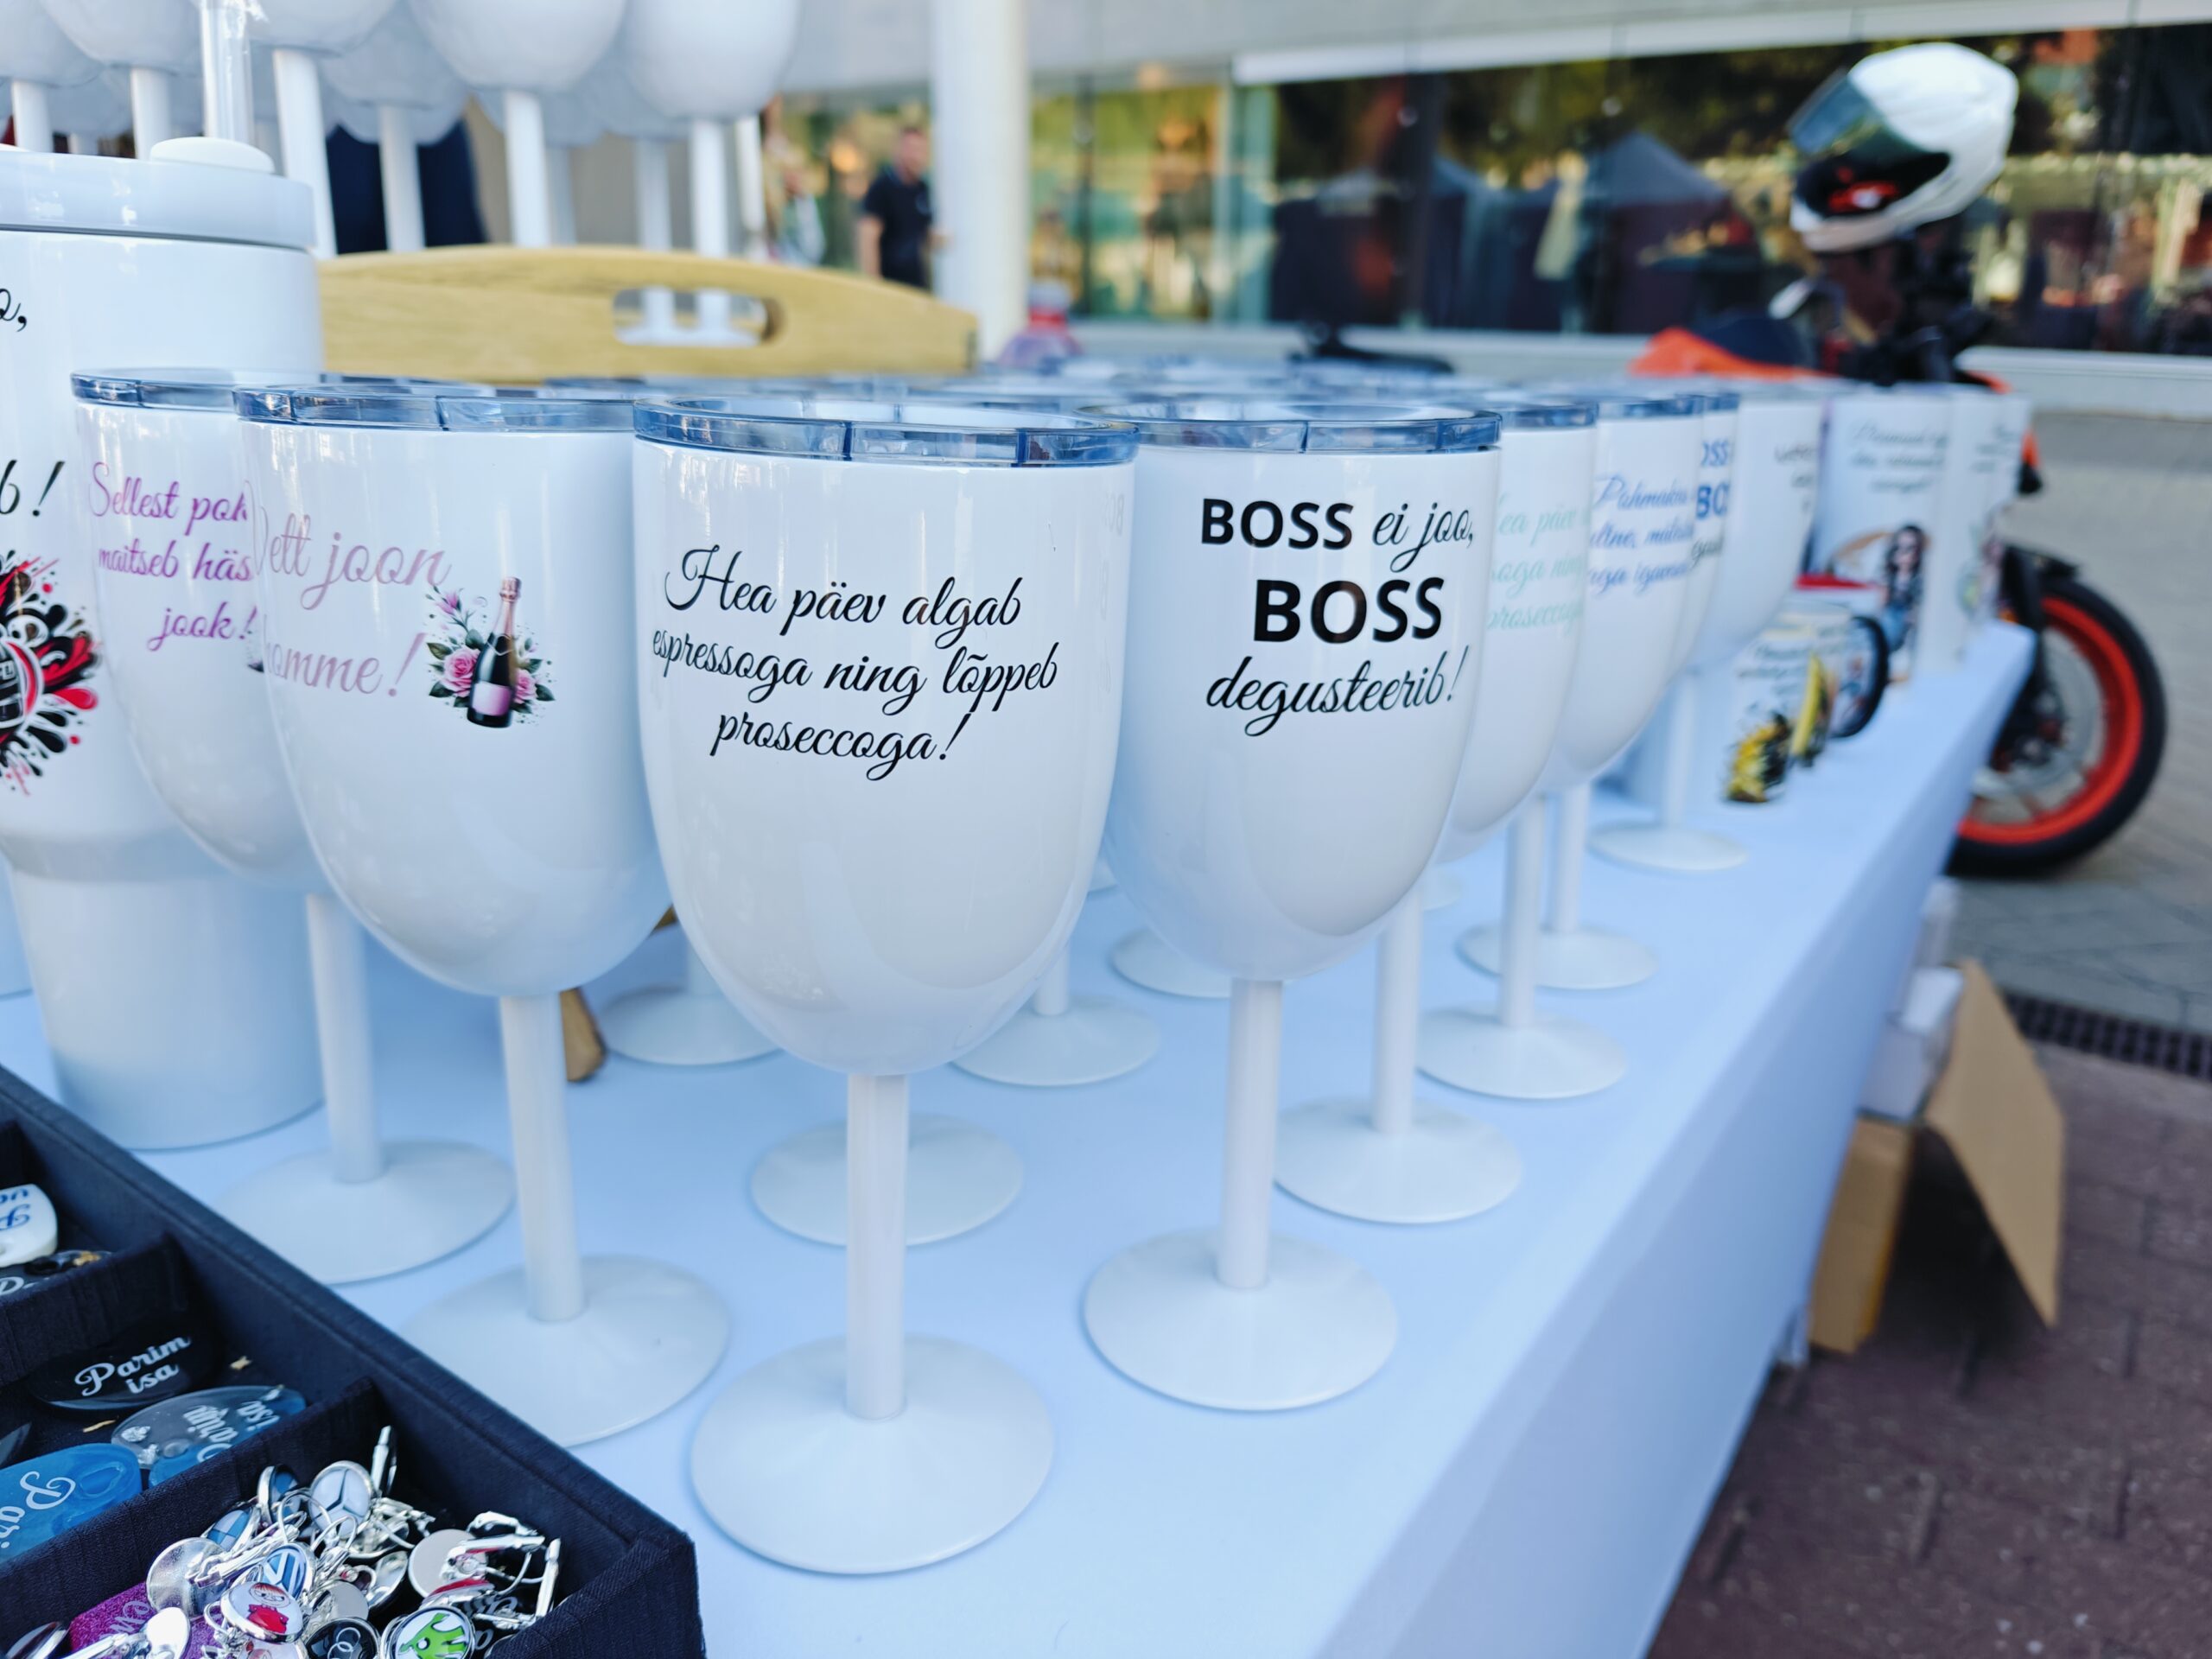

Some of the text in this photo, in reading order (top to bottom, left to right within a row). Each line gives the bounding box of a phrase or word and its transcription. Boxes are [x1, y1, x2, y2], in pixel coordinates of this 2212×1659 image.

[89, 461, 180, 518] Sellest
[99, 537, 253, 582] maitseb häs
[301, 531, 453, 610] joon
[1201, 498, 1474, 574] BOSS ei joo,
[147, 601, 257, 652] jook!
[664, 544, 1023, 650] Hea päev algab
[1253, 576, 1446, 645] BOSS
[652, 626, 1060, 716] espressoga ning lõppeb
[1205, 645, 1470, 737] degusteerib!
[709, 710, 972, 781] proseccoga!
[74, 1337, 192, 1397] Parim
[125, 1363, 180, 1394] isa
